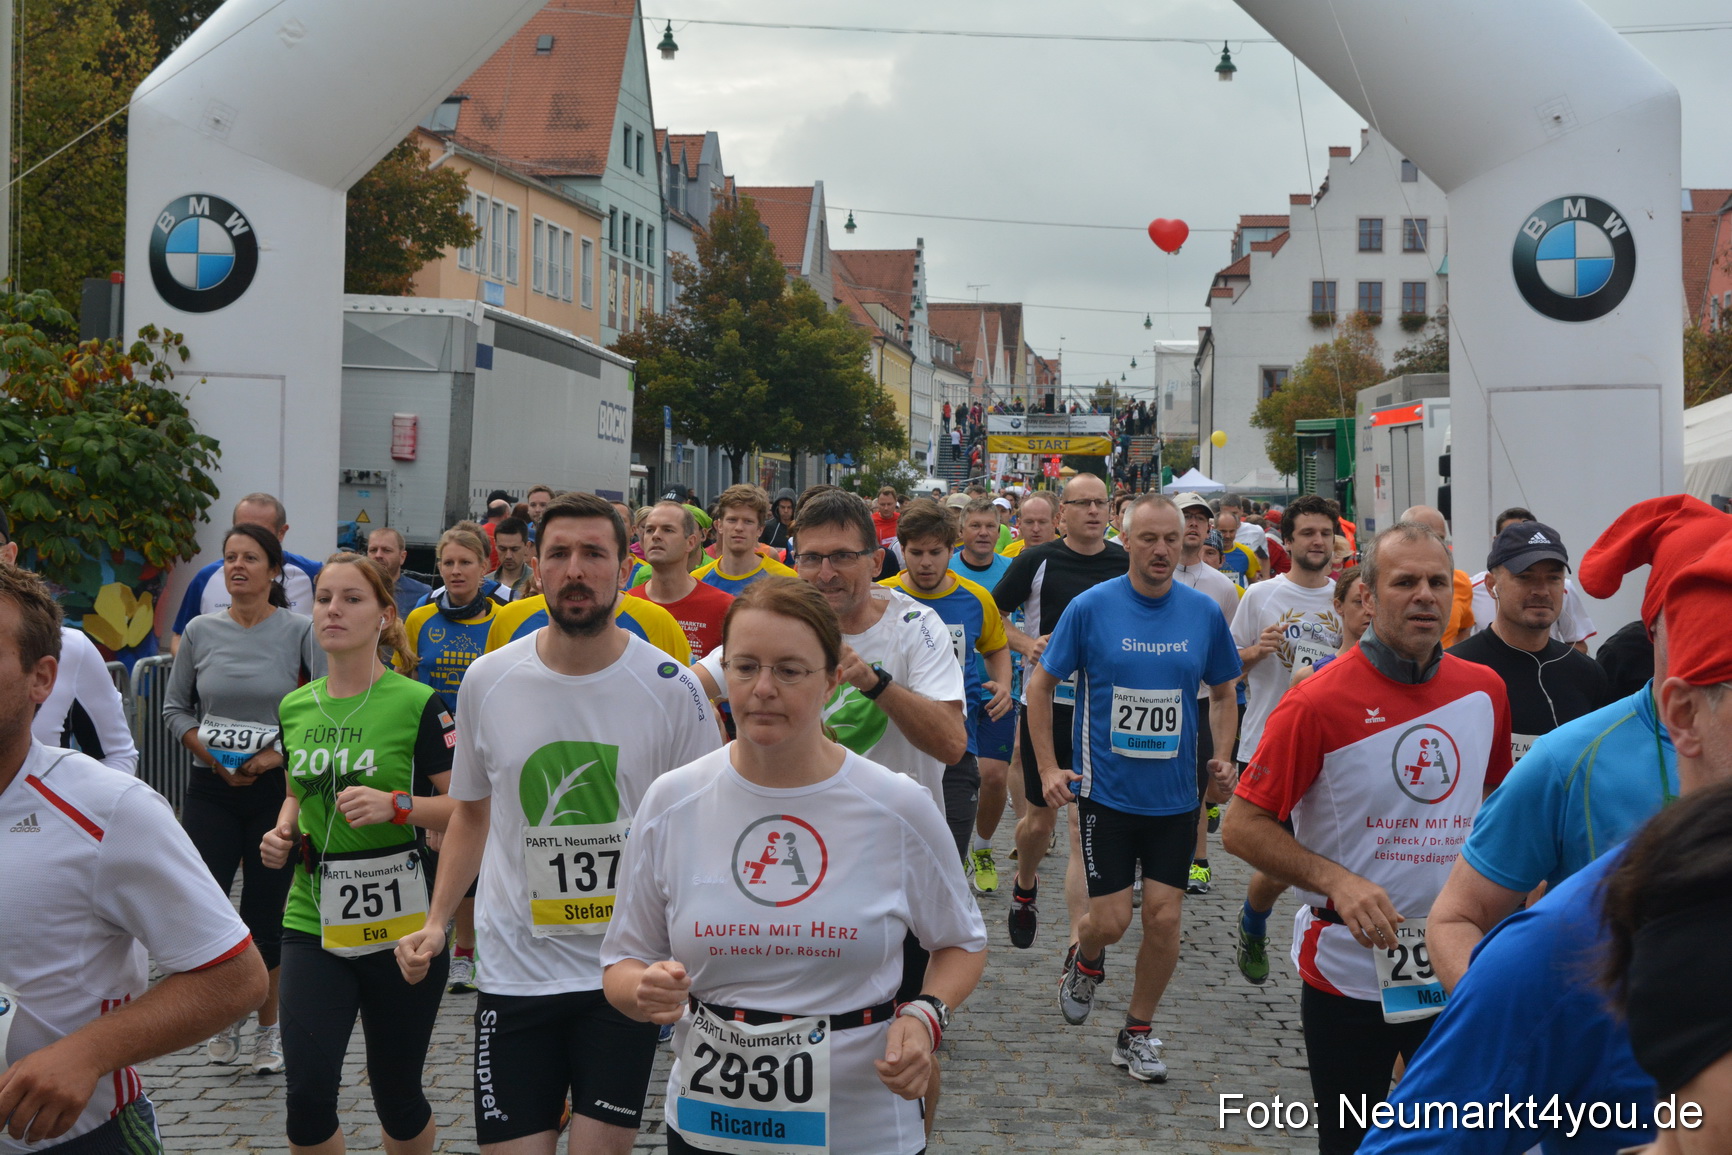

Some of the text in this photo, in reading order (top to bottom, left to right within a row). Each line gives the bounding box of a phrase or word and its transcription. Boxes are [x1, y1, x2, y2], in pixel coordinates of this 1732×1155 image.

[157, 196, 250, 237] BMW
[1522, 198, 1628, 241] BMW
[1028, 439, 1071, 450] START
[1114, 693, 1173, 704] PARTL Neumarkt
[203, 719, 229, 728] PARTL
[1118, 705, 1177, 732] 2709
[1364, 716, 1386, 724] erima
[207, 728, 270, 750] 2397
[304, 725, 363, 744] FÜRTH
[1128, 737, 1166, 749] Günther
[291, 748, 378, 777] 2014
[10, 824, 42, 833] adidas
[1366, 816, 1419, 829] LAUFEN
[1425, 818, 1448, 829] MIT
[525, 834, 621, 848] PARTL Neumarkt
[1377, 836, 1390, 845] Dr.
[1393, 836, 1419, 845] Heck
[1430, 837, 1443, 846] Dr.
[323, 864, 403, 880] PARTL Neumarkt
[549, 850, 621, 893] 137
[340, 878, 402, 919] 251
[564, 903, 613, 920] Stefan
[363, 927, 388, 941] Eva
[695, 921, 858, 940] LAUFEN MIT HERZ
[709, 944, 841, 958] Dr. Heck / Dr. Röschl
[1387, 942, 1436, 981] 29
[692, 1016, 802, 1048] PARTL Neumarkt
[689, 1042, 814, 1104] 2930
[710, 1110, 786, 1138] Ricarda
